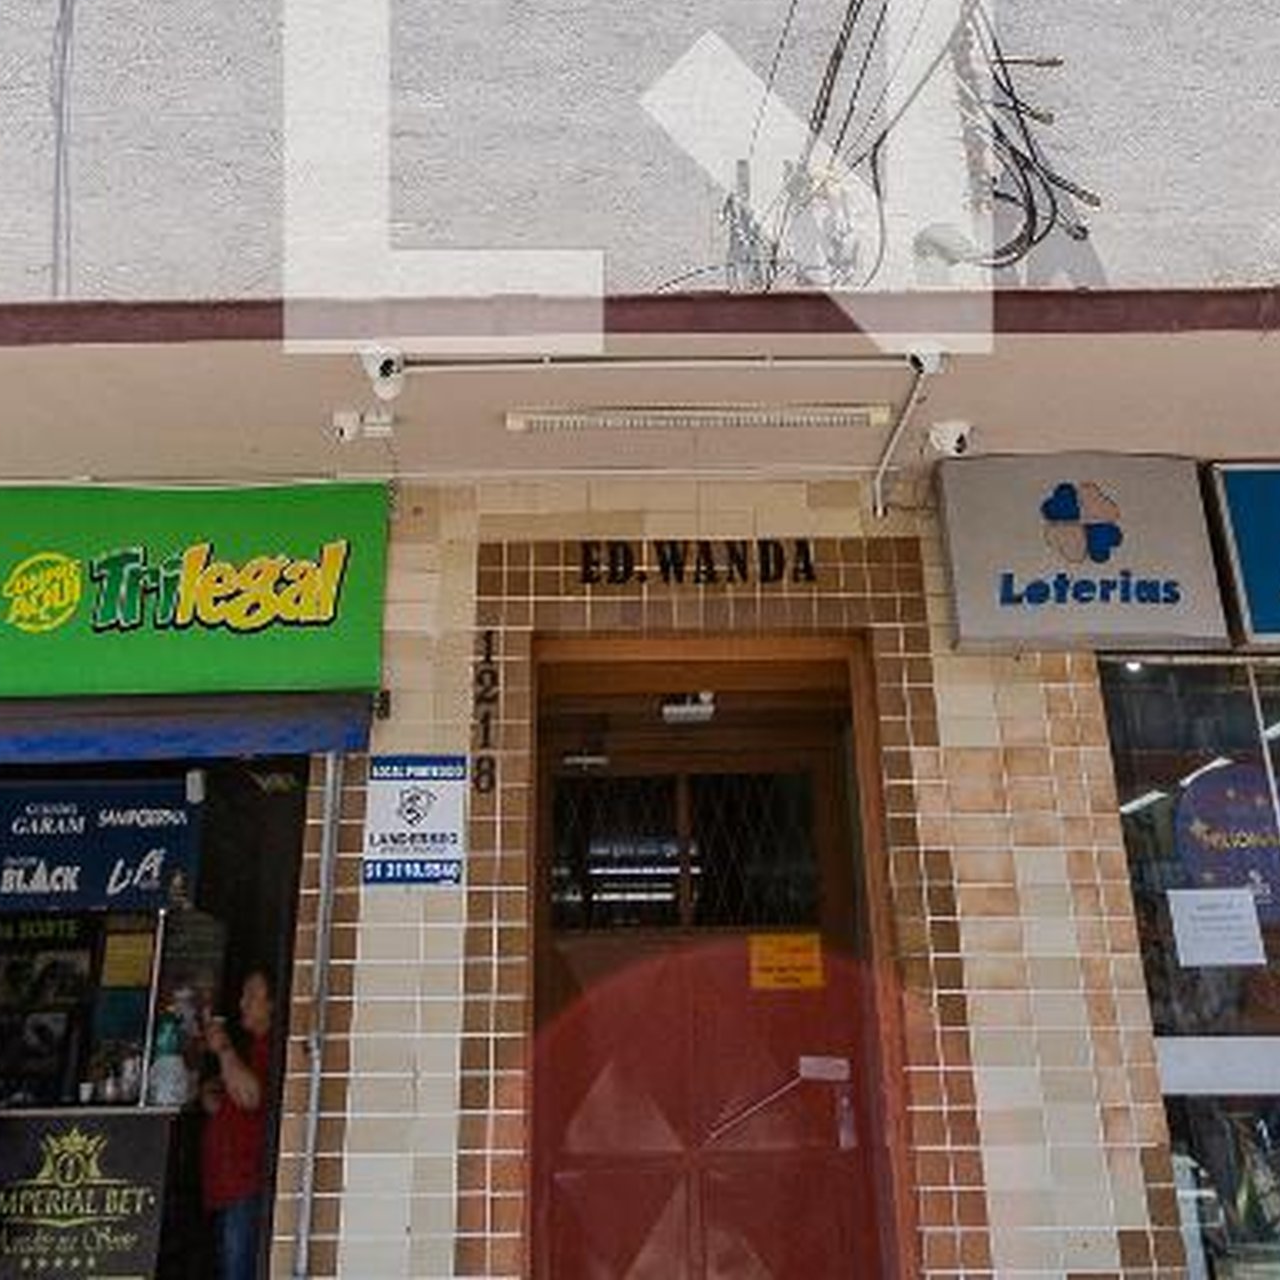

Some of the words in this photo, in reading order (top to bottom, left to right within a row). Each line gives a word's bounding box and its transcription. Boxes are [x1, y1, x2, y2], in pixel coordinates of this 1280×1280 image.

[91, 540, 350, 633] Trilegal
[999, 570, 1182, 606] Loterias
[474, 629, 500, 794] 1218
[11, 815, 86, 835] GARAM
[0, 859, 82, 894] BLACK
[104, 1187, 151, 1214] BET
